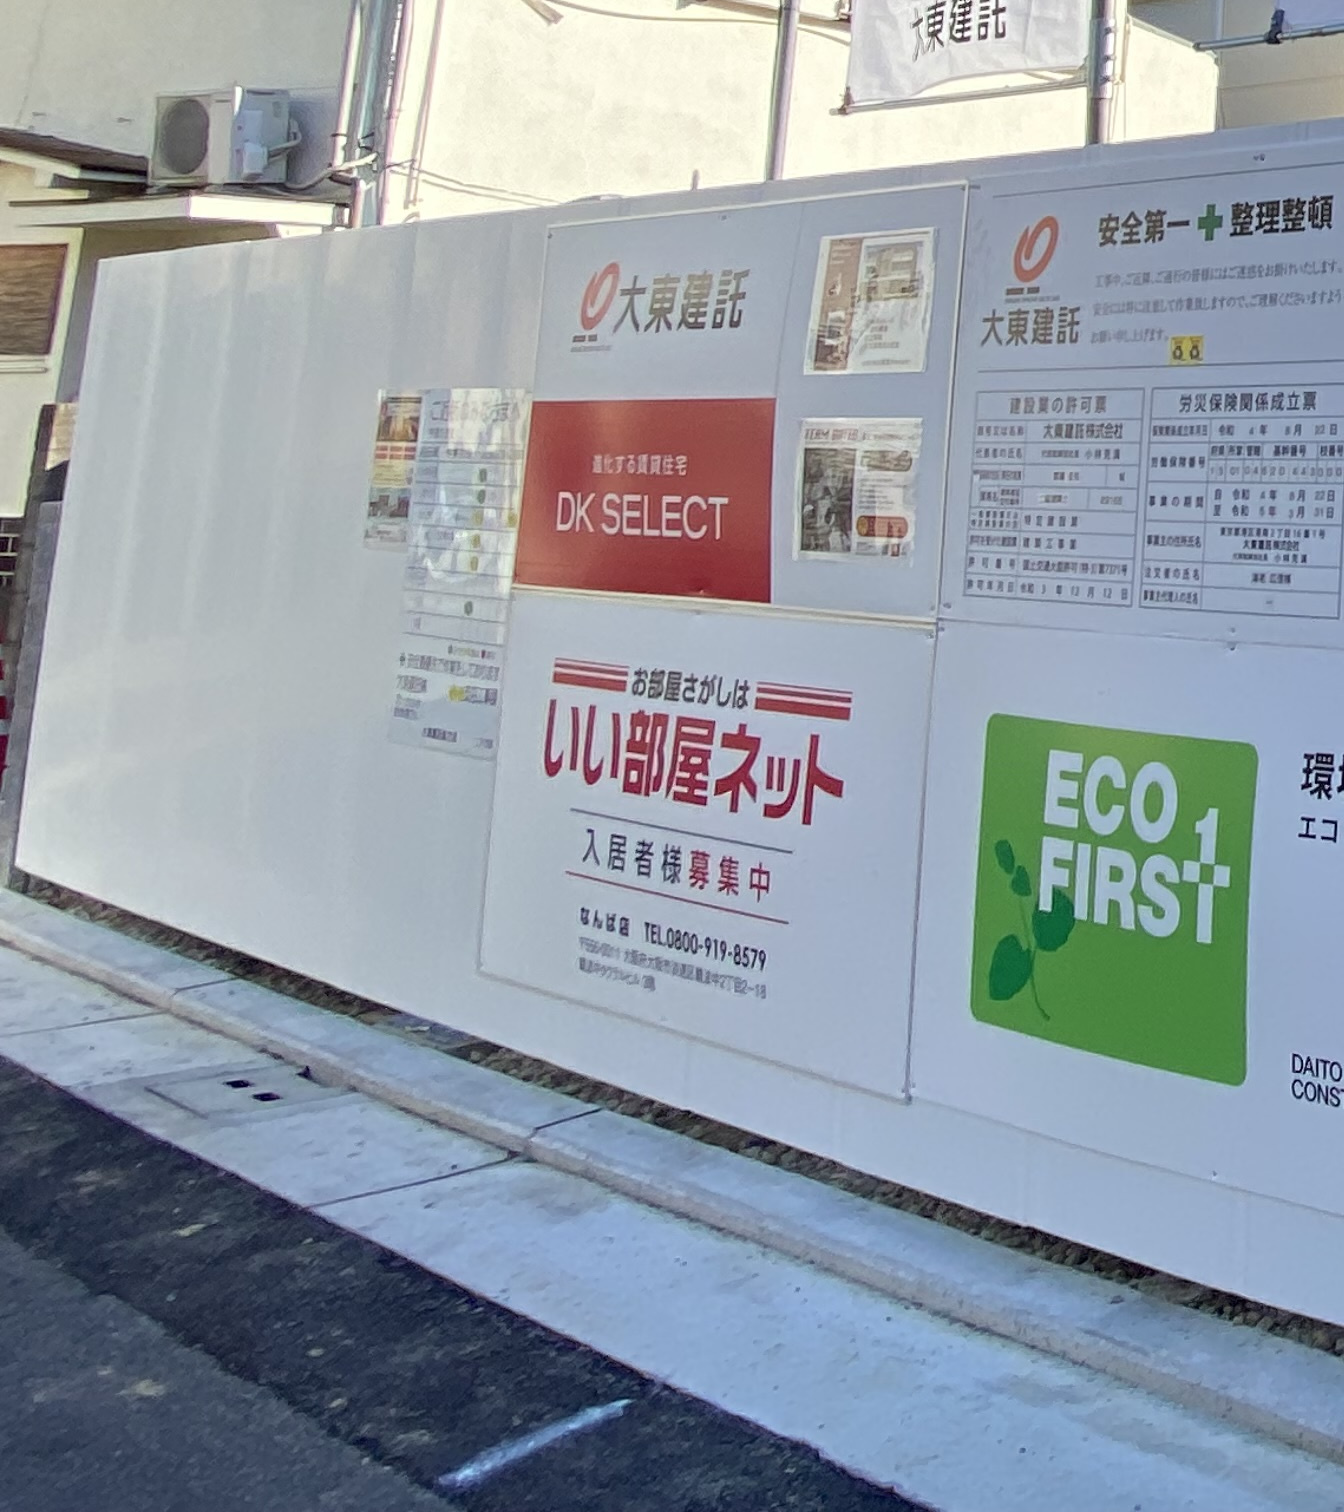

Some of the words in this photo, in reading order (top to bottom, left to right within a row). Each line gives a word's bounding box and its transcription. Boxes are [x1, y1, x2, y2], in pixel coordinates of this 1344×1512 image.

[1099, 209, 1190, 247] 安全第一
[1230, 195, 1334, 237] 整理整頓
[612, 268, 750, 333] 大東建託
[980, 306, 1081, 348] 大東建託
[1009, 395, 1107, 415] 建設業の許可票
[1179, 391, 1317, 413] 労災保険関係成立票
[556, 491, 597, 533] DK
[601, 493, 729, 541] SELECT
[631, 666, 751, 710] お部屋さがしは
[542, 697, 845, 826] いい部屋ネット
[1043, 748, 1179, 844] ECO
[582, 828, 772, 903] 入居者様募集中
[1038, 835, 1231, 944] FIRST
[1291, 1053, 1343, 1083] DAITO
